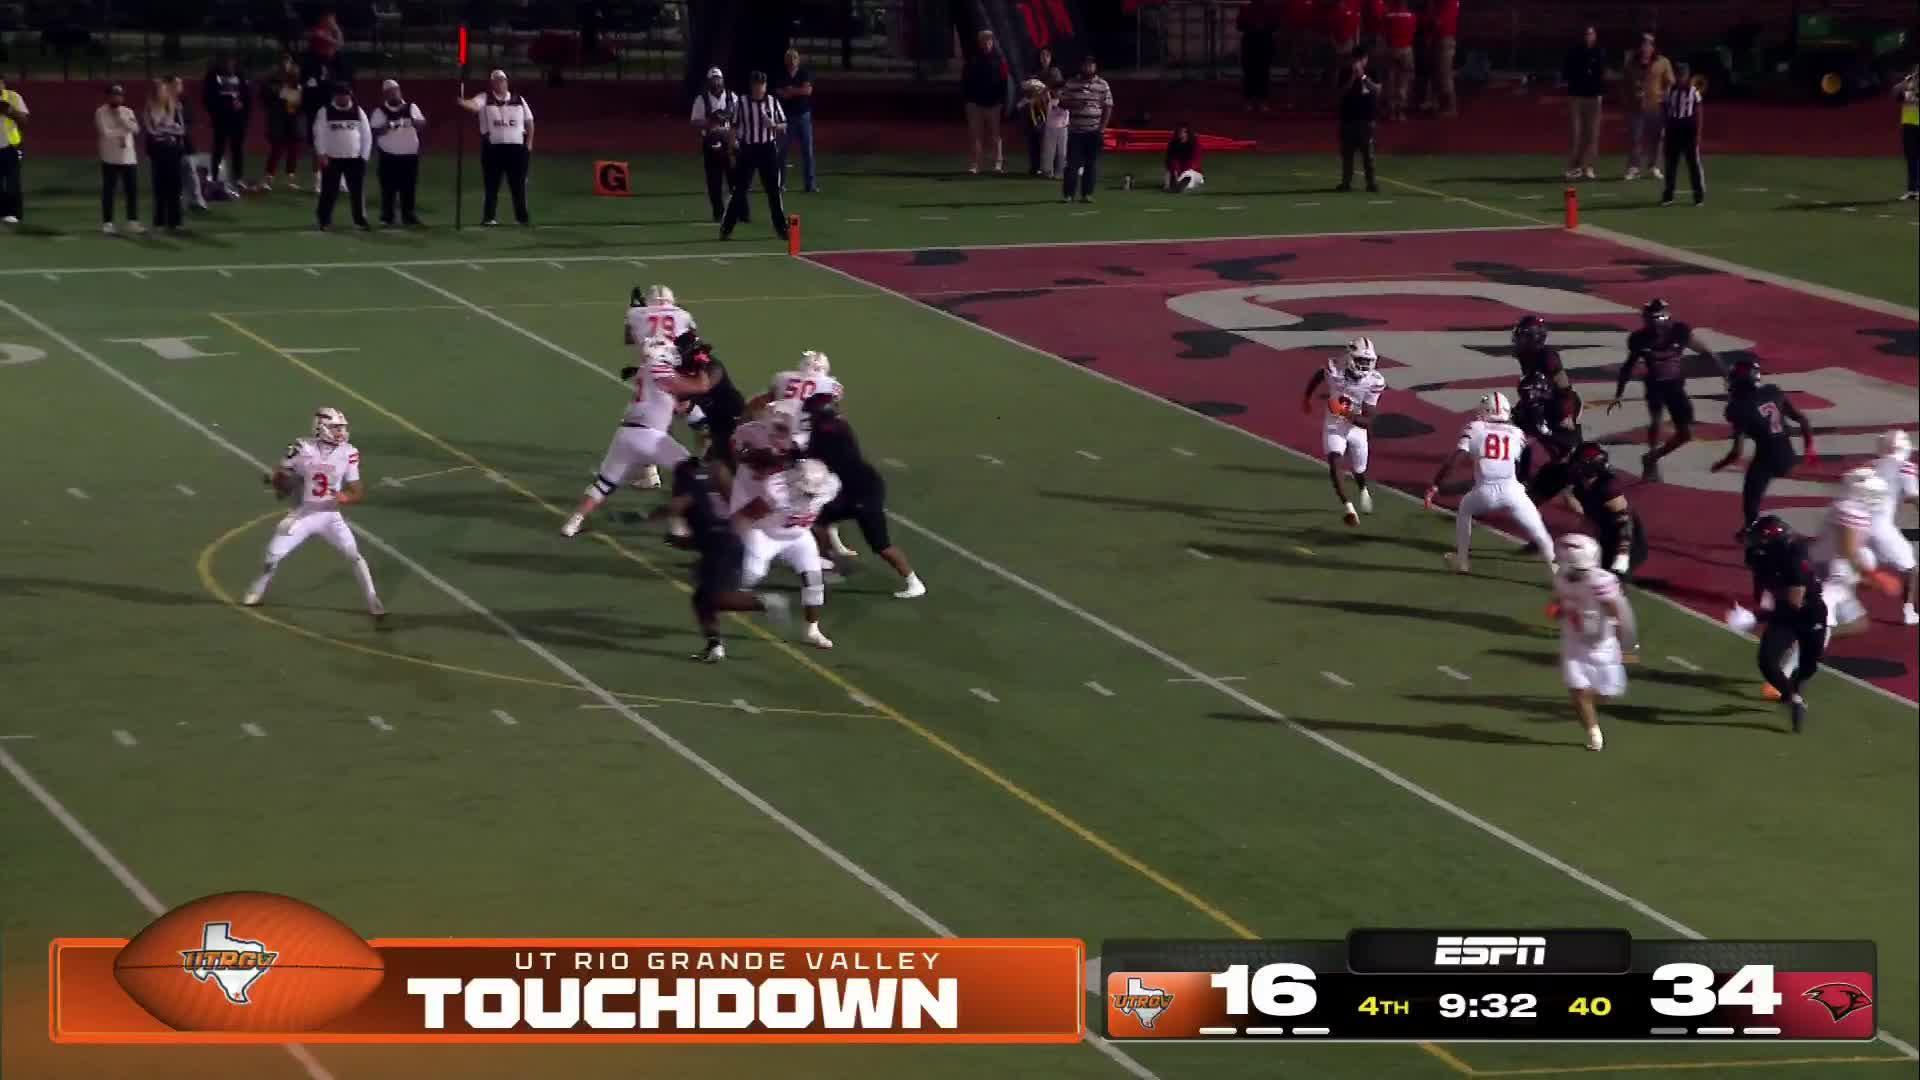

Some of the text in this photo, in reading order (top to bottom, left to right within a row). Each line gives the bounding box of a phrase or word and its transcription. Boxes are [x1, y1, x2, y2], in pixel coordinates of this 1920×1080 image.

[600, 164, 626, 192] G
[647, 315, 676, 341] 79
[784, 377, 817, 401] 50
[1485, 433, 1511, 461] 81
[311, 472, 329, 497] 3
